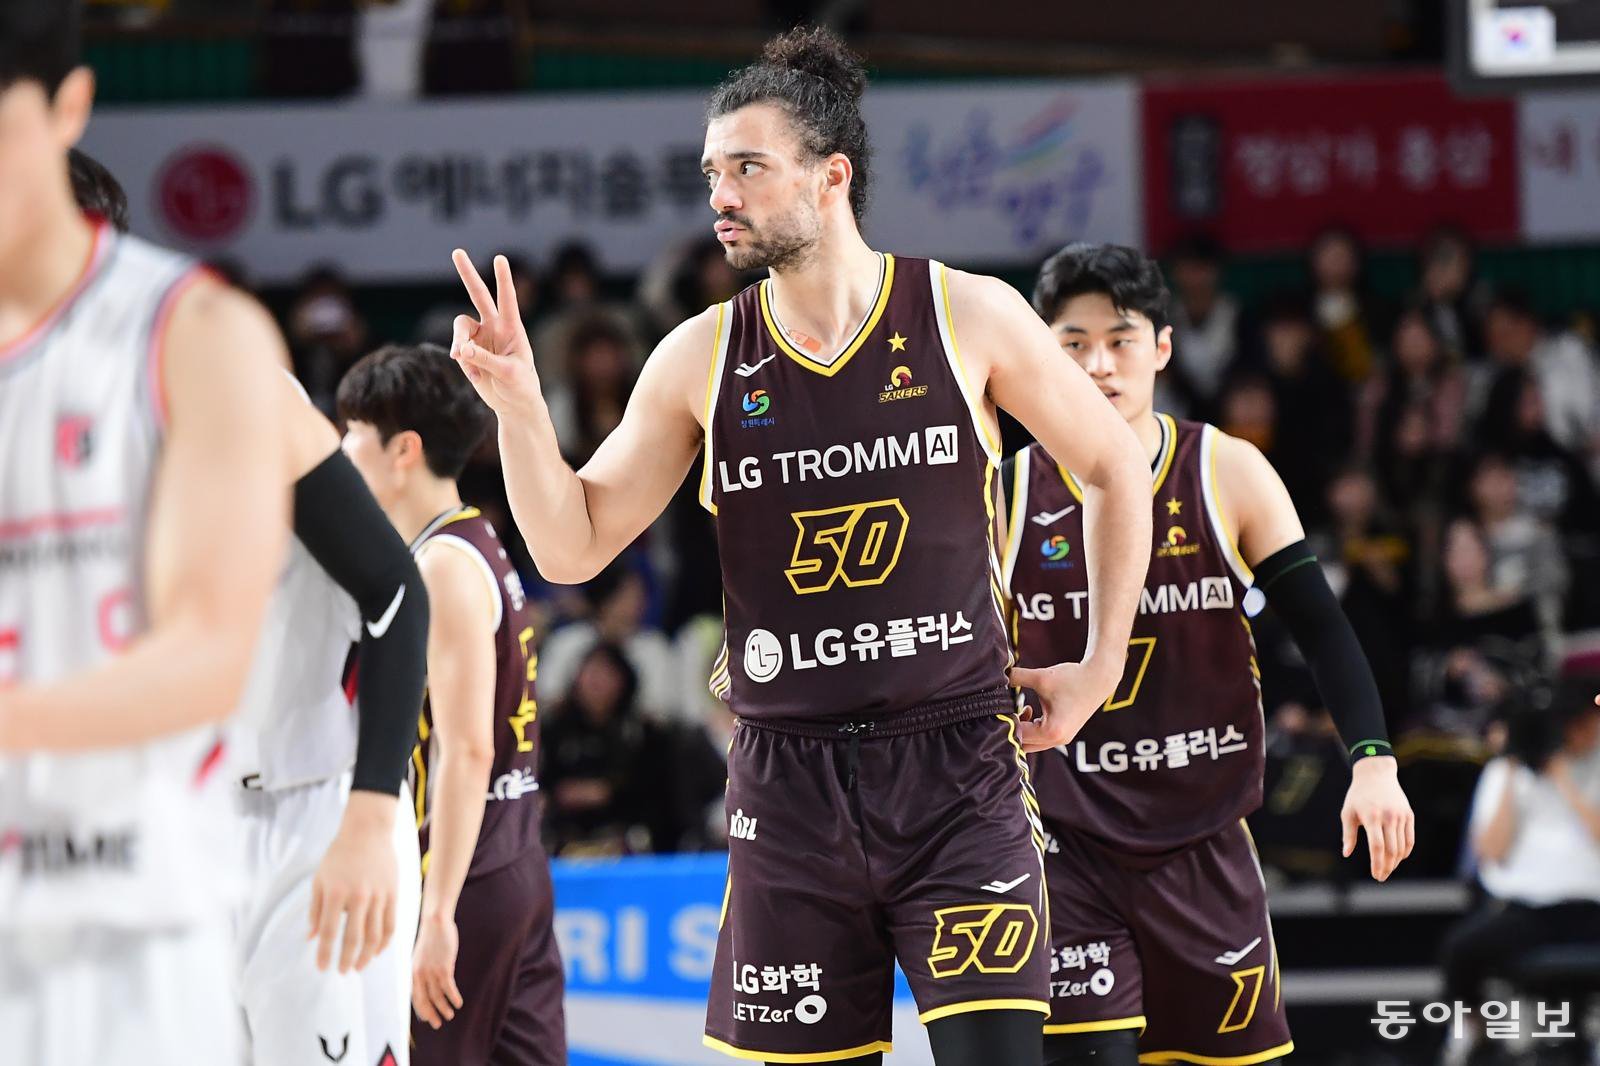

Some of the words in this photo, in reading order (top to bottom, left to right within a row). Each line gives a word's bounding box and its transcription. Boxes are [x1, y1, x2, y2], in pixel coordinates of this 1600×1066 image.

[878, 385, 928, 403] SAKERS
[719, 455, 763, 493] LG
[772, 432, 921, 485] TROMM
[784, 498, 910, 595] 50
[1016, 592, 1055, 621] LG
[1064, 582, 1199, 619] TMM
[790, 611, 974, 671] LG유플러스
[927, 903, 1038, 979] 50
[733, 960, 823, 995] LG화학
